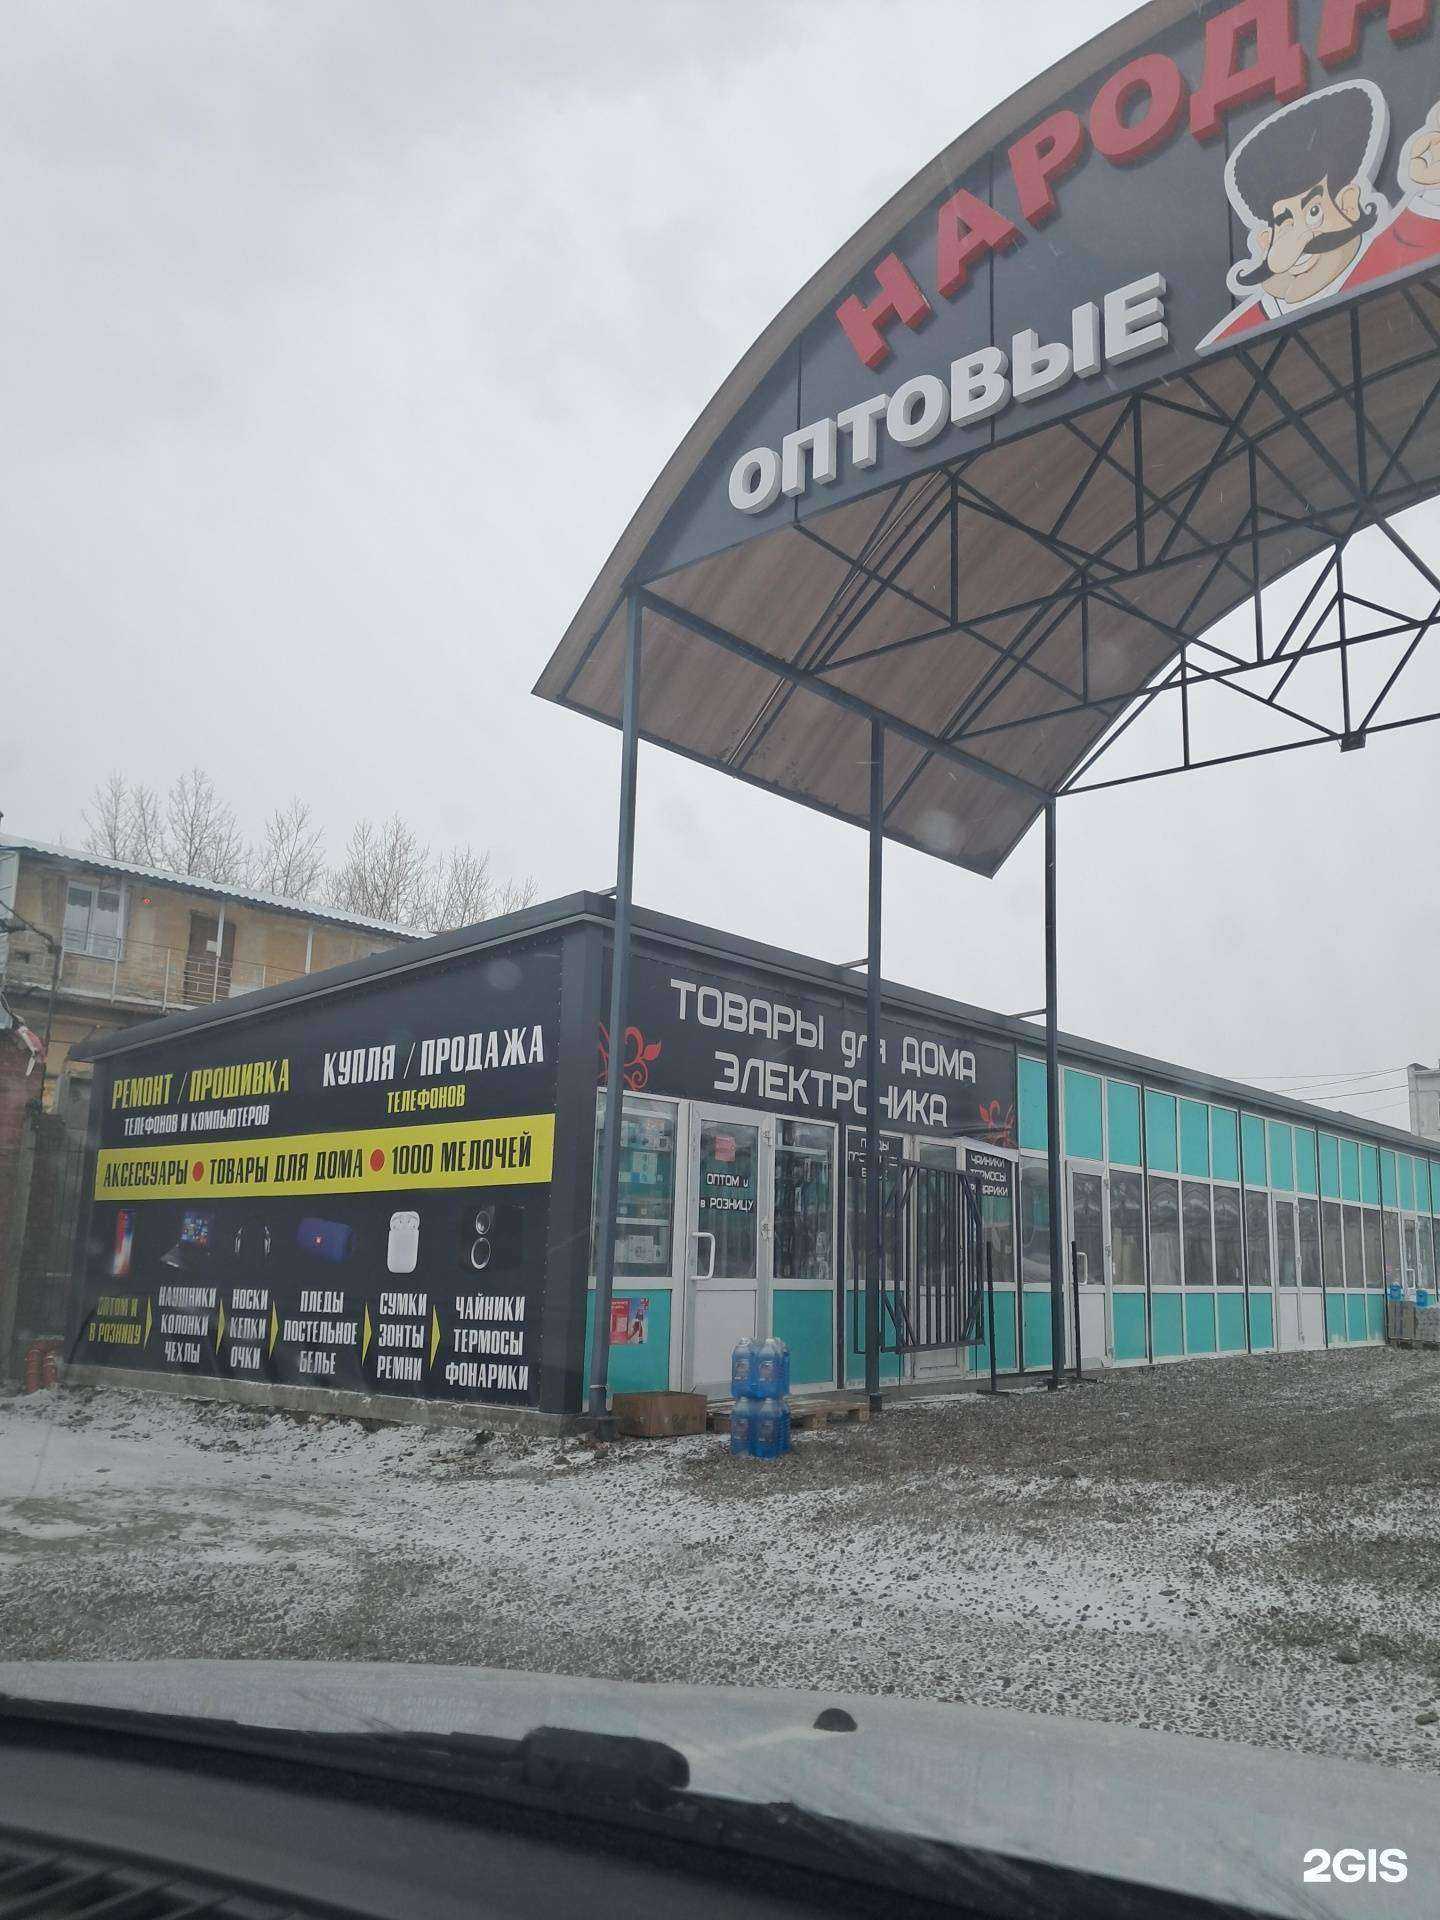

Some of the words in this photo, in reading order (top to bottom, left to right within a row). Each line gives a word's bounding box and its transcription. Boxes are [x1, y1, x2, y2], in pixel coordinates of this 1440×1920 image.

[728, 272, 1168, 514] ОПТОВЫЕ
[670, 978, 824, 1051] ТОВАРЫ
[901, 1037, 977, 1084] ДОМА
[322, 1045, 397, 1088] КУПЛЯ
[111, 1073, 174, 1110] РЕМОНТ
[387, 1085, 466, 1114] ТЕЛЕФОНОВ
[124, 1114, 178, 1137] ТЕЛЕФОНОВ
[181, 1113, 188, 1133] И
[190, 1105, 270, 1132] КОМПЬЮТЕРОВ
[391, 1144, 434, 1176] 1000
[440, 1130, 532, 1172] МЕЛОЧЕЙ
[103, 1160, 188, 1188] АКСЕССУАРЫ
[210, 1155, 269, 1187] ТОВАРЫ
[273, 1153, 308, 1183] ДЛЯ
[313, 1149, 364, 1182] ДОМА
[706, 1173, 739, 1188] ОПТОМ
[709, 1197, 755, 1213] РОЗНИЦУ
[158, 1285, 217, 1309] НАУШНИКИ
[232, 1288, 269, 1311] НОСКИ
[300, 1289, 344, 1315] ПЛЕДЫ
[379, 1291, 428, 1317] СУМКИ
[455, 1292, 526, 1323] ЧАЙНИКИ
[97, 1323, 142, 1345] РОЗНИЦУ
[160, 1313, 209, 1337] КОЛОНКИ
[229, 1316, 267, 1340] КЕПКИ
[283, 1319, 359, 1346] ПОСТЕЛЬНОЕ
[378, 1323, 425, 1349] ЗОНТЫ
[165, 1341, 200, 1364] ЧЕХЛЫ
[453, 1329, 524, 1357] ТЕРМОСЫ
[230, 1345, 261, 1370] ОЧКИ
[299, 1350, 336, 1376] БЕЛЬЕ
[376, 1354, 423, 1382] РЕМНИ
[445, 1362, 529, 1392] ФОНАРИКИ
